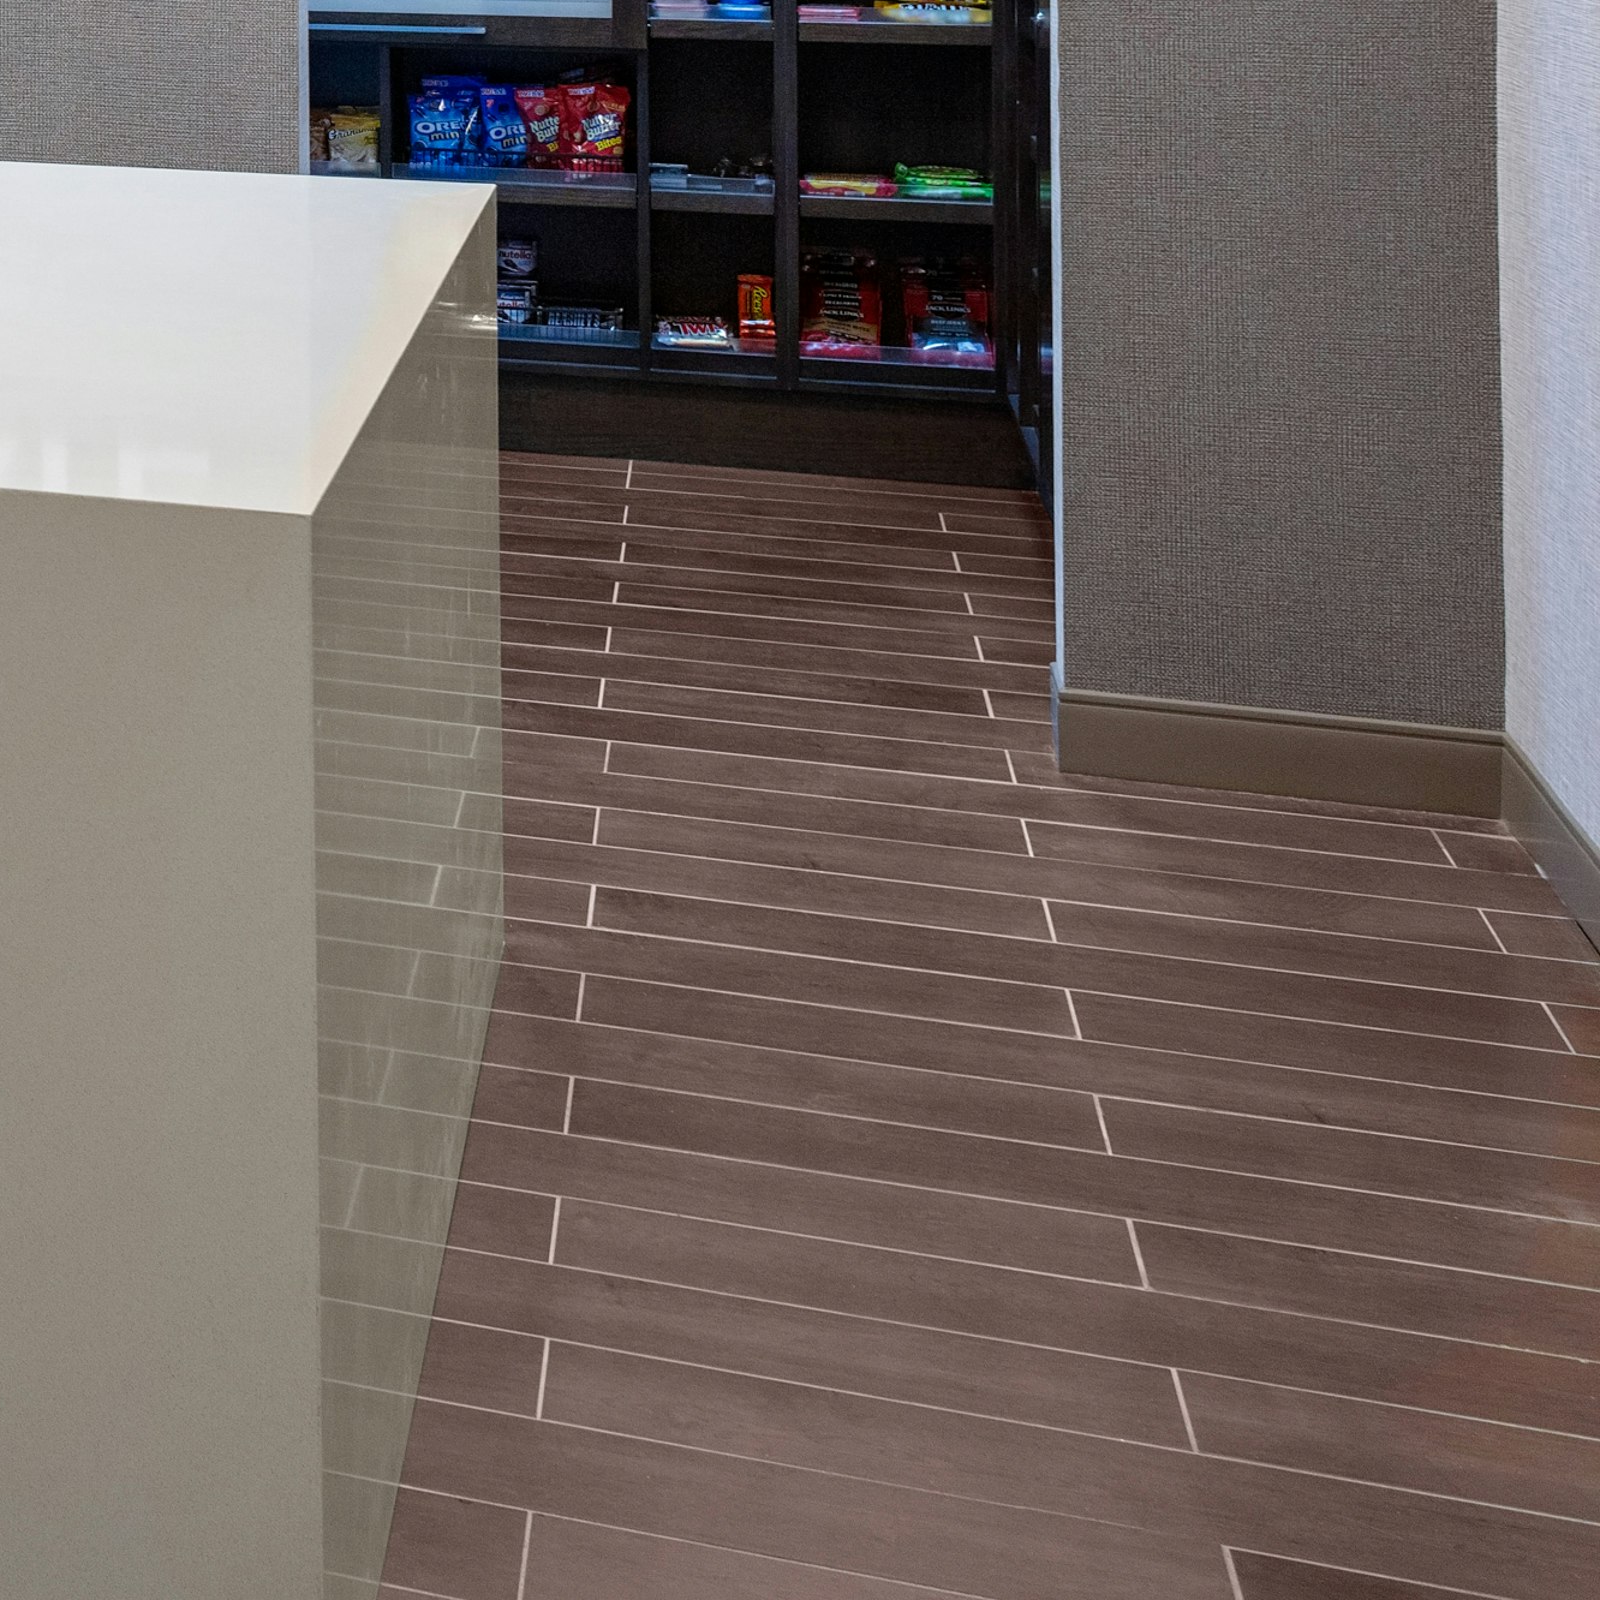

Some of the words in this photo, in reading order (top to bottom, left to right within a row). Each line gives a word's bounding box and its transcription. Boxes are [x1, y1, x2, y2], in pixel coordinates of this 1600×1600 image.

[416, 120, 462, 135] ORE
[529, 115, 560, 132] Nutte
[430, 130, 460, 142] min
[489, 123, 527, 141] ORE
[535, 126, 560, 143] Butt
[502, 135, 527, 148] min
[596, 136, 623, 151] Bites
